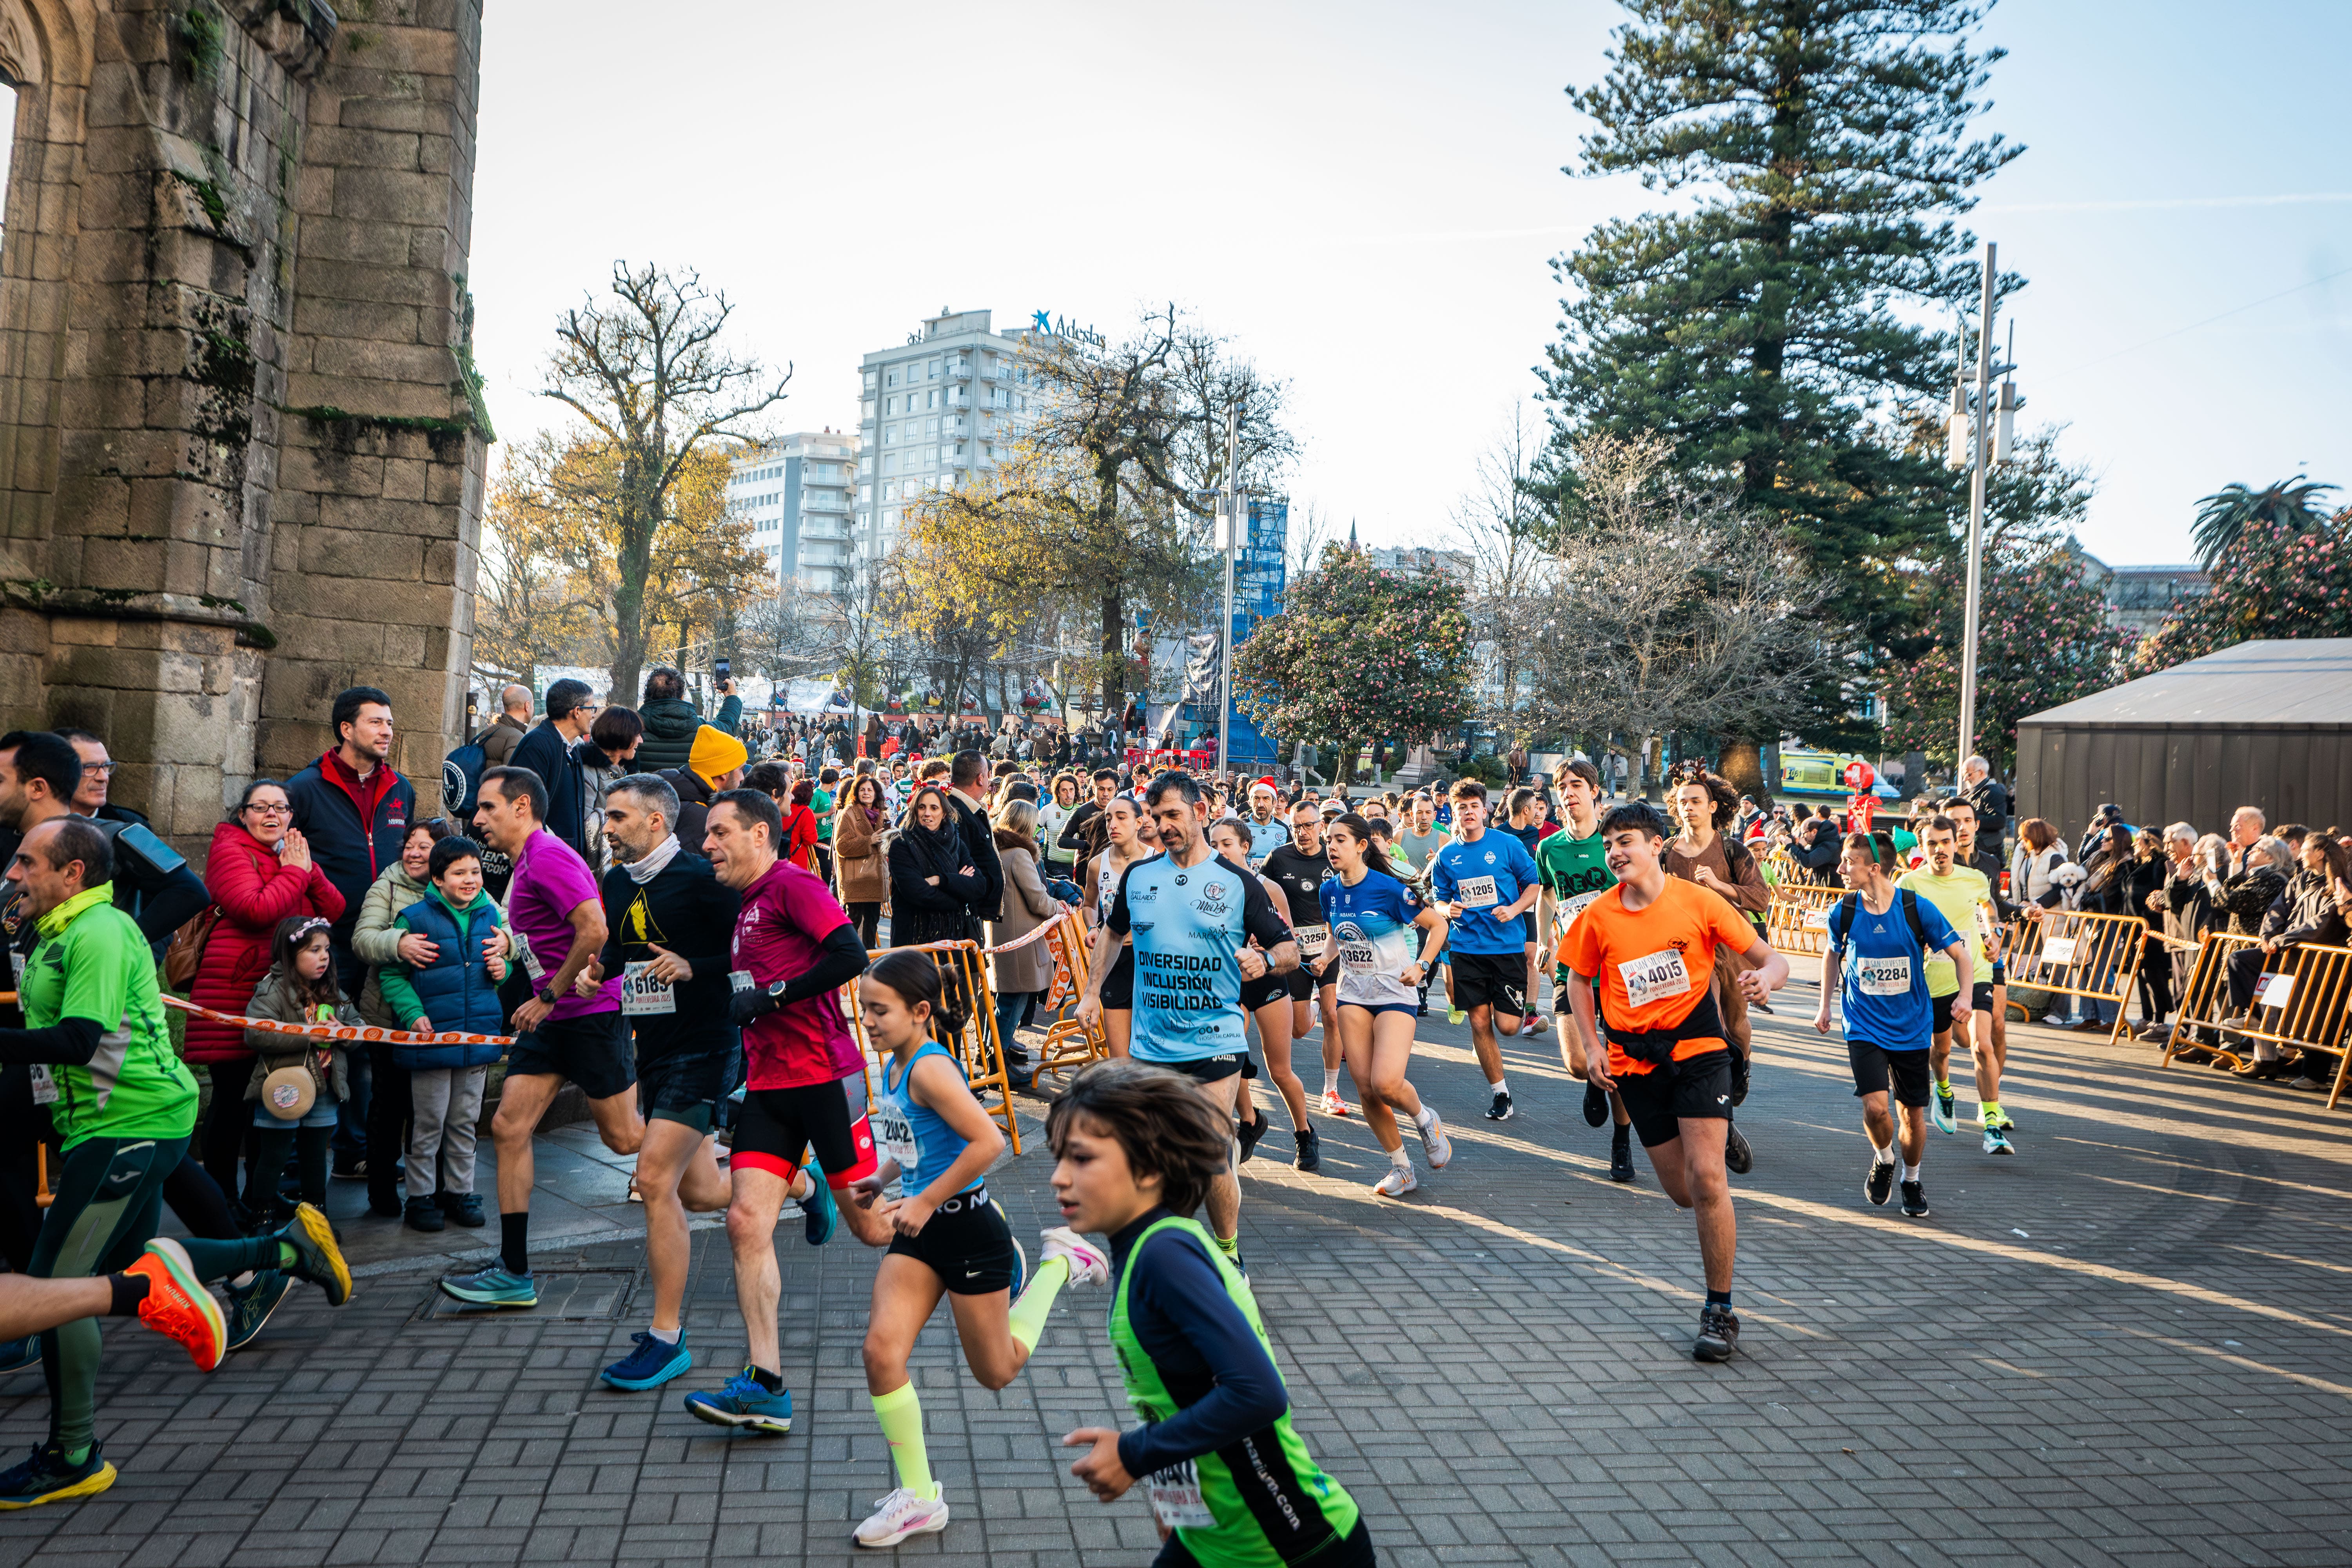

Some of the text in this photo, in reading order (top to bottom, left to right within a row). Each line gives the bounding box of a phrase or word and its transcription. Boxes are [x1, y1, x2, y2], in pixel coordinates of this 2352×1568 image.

[1055, 313, 1105, 347] Adeslas
[1472, 884, 1493, 896] 1205
[1305, 932, 1327, 944] 3250
[1138, 951, 1222, 971] DIVERSIDAD
[1346, 950, 1372, 962] 3622
[1635, 958, 1648, 971] SAN
[1648, 950, 1677, 966] SILVESTRE
[1882, 959, 1907, 967] SILVESTRE
[1143, 972, 1212, 991] INCLUSIÓN
[1648, 960, 1682, 984] 4015
[1877, 967, 1908, 981] 2284
[1650, 982, 1675, 993] PONTEVEDRA
[635, 994, 671, 1004] PONTEVEDRA 2025
[1142, 991, 1223, 1010] VISIBILIDAD
[885, 1118, 912, 1142] 2842
[163, 1284, 191, 1310] KIPRUN
